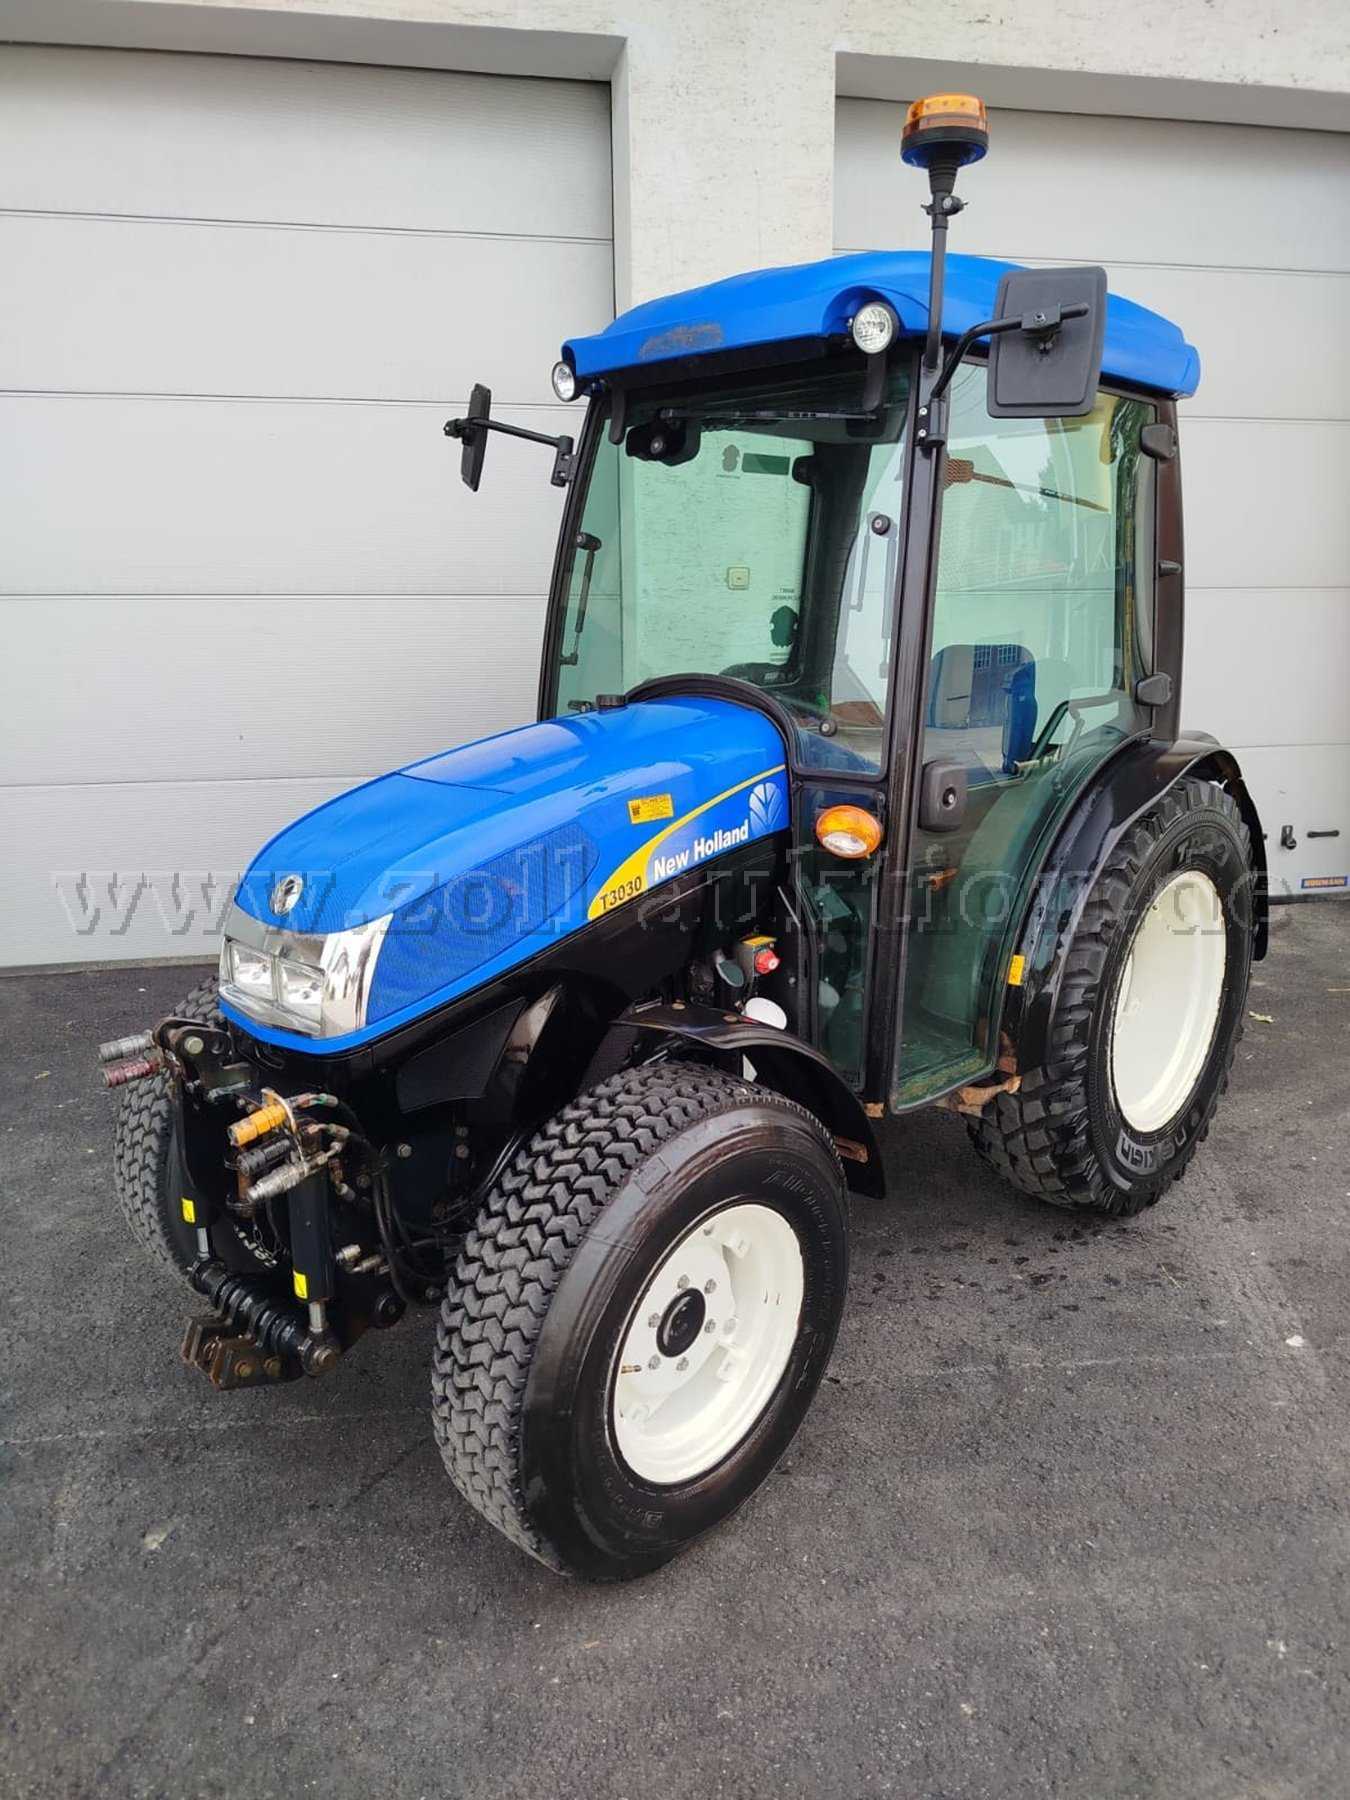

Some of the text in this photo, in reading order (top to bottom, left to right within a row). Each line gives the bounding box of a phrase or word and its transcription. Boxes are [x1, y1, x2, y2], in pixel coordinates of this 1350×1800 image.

[654, 819, 749, 881] New Holland
[600, 876, 642, 910] T3030
